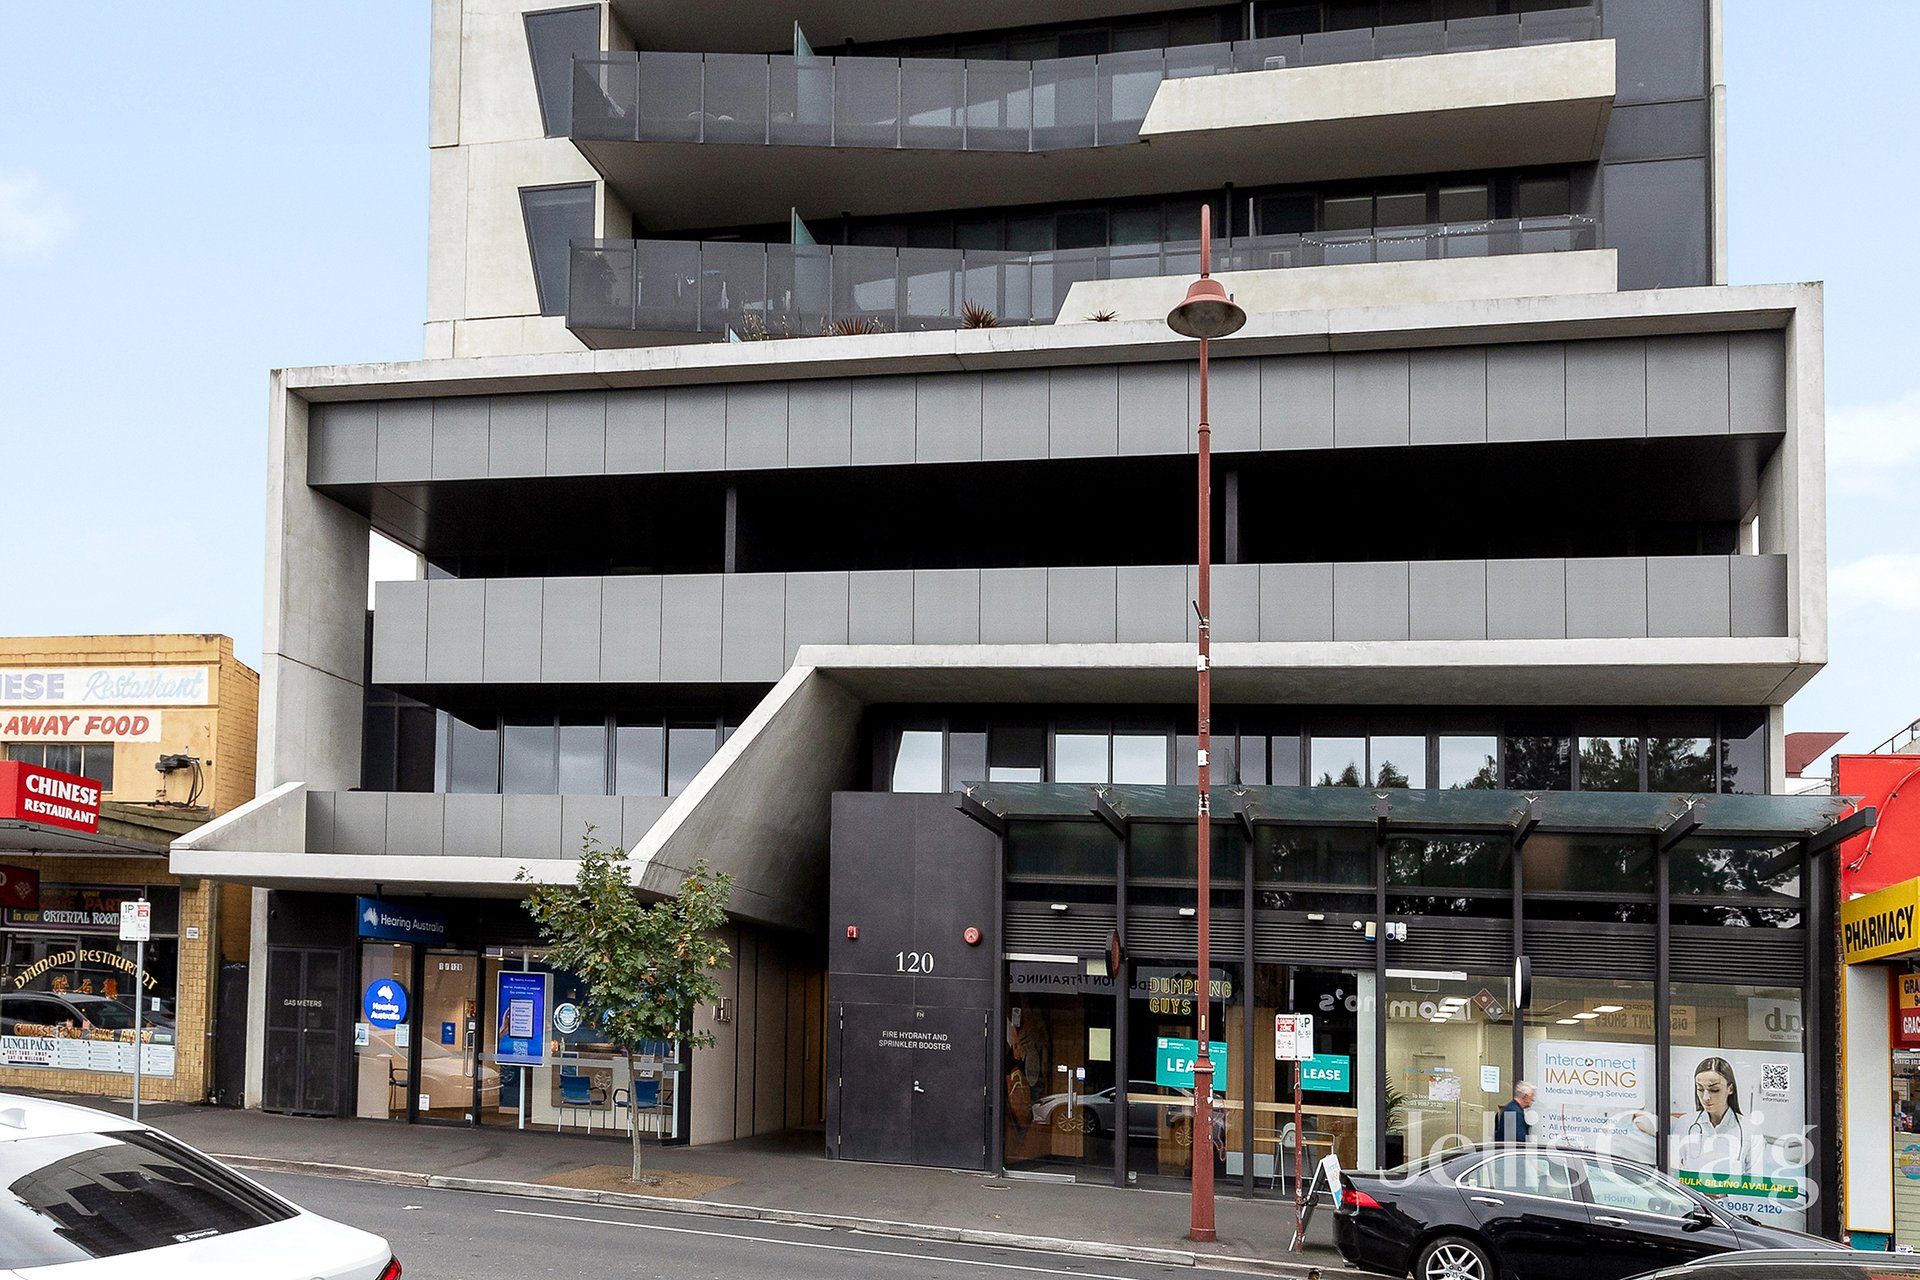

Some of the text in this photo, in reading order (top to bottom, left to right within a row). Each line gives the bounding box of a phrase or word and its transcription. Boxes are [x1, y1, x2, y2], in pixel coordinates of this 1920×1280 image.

[0, 670, 204, 702] ESE Restaurant
[84, 715, 149, 736] FOOD
[25, 774, 98, 807] CHINESE
[24, 798, 97, 825] RESTAURANT
[13, 910, 23, 920] in
[24, 912, 38, 921] our
[43, 910, 89, 924] ORIENTAL
[92, 912, 119, 925] ROOM
[381, 913, 444, 933] Hearing Australia
[1845, 904, 1914, 953] PHARMACY
[13, 950, 76, 989] DIAMOND
[895, 951, 934, 974] 120
[1150, 977, 1232, 999] DUMPLNG
[297, 999, 322, 1007] METERS
[372, 1002, 399, 1014] Hearing
[1150, 997, 1191, 1015] GUYS
[370, 1011, 400, 1020] Australia
[13, 1023, 54, 1037] CHINESE
[58, 1026, 83, 1039] FOOD
[882, 1030, 948, 1041] FIRE HYDRANT AND
[2, 1037, 55, 1051] LUNCH PACKS
[878, 1039, 951, 1051] SPRINKLER BOOSTER
[1545, 1053, 1636, 1070] Interconnect
[1303, 1068, 1341, 1081] LEASE
[1545, 1068, 1637, 1089] IMAGING
[1545, 1087, 1637, 1099] Medical Imaging Services
[1560, 1124, 1591, 1133] referrals
[1678, 1177, 1794, 1193] BULK BILLING AVAILABLE
[1727, 1201, 1754, 1212] 9087
[1757, 1203, 1783, 1214] 2120
